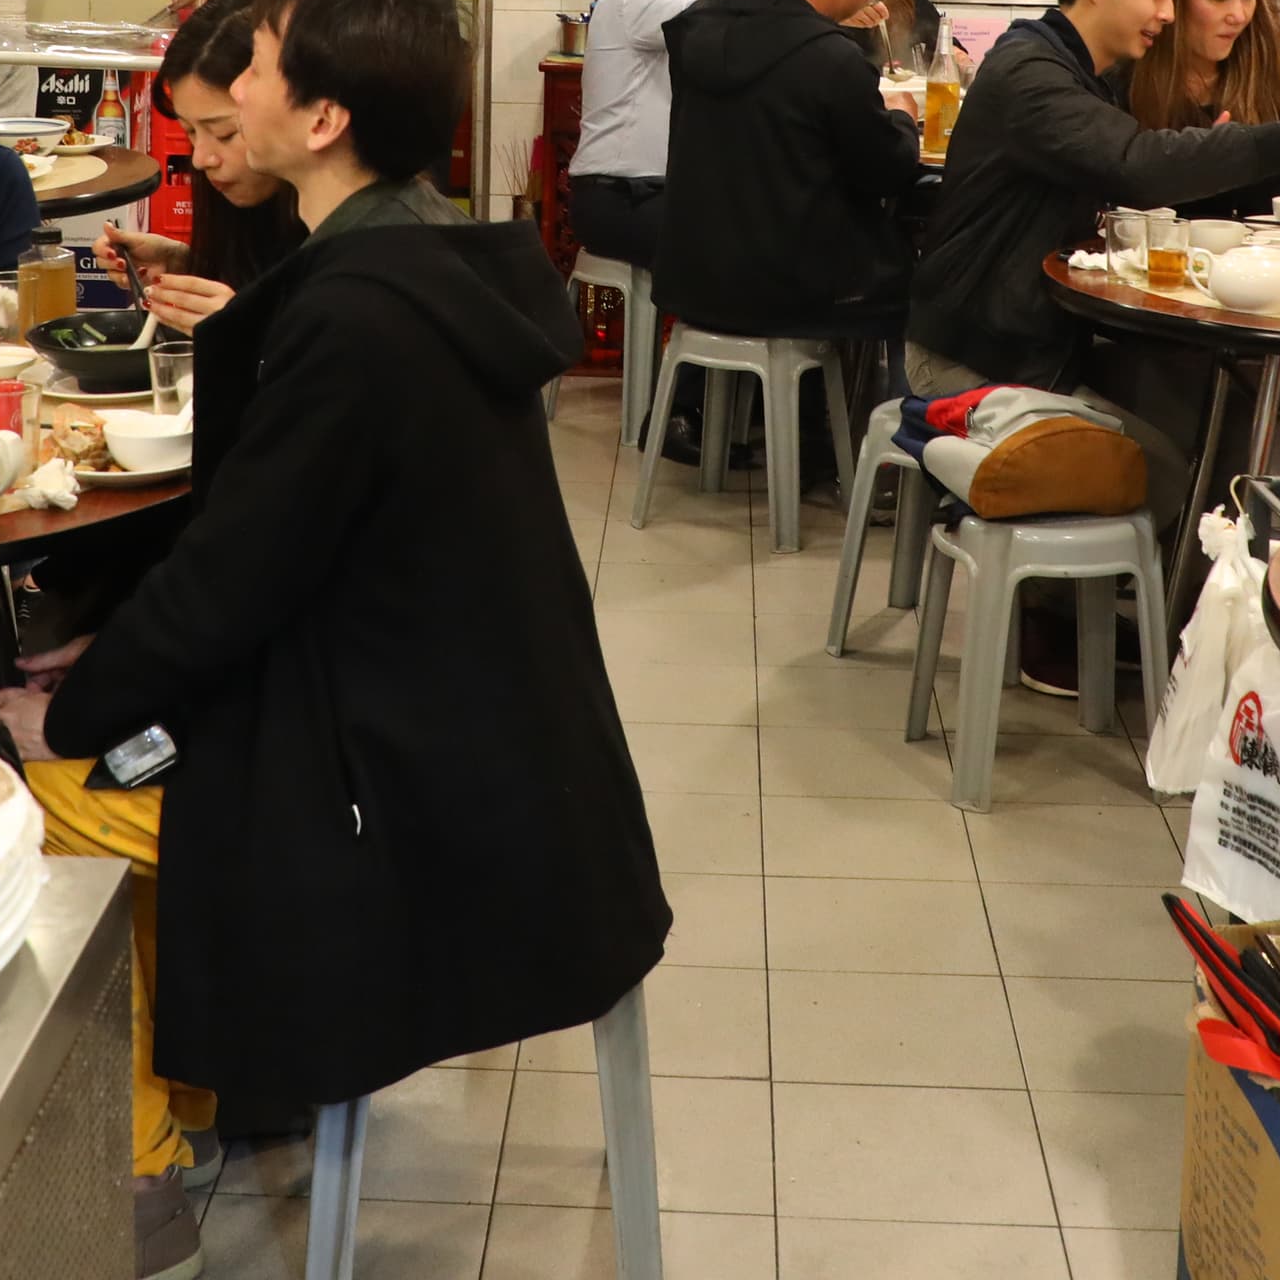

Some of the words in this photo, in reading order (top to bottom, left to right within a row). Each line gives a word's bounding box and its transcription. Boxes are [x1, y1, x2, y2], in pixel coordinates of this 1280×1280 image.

[40, 73, 90, 94] Asahi
[57, 96, 76, 106] 辛口
[80, 258, 97, 269] GI
